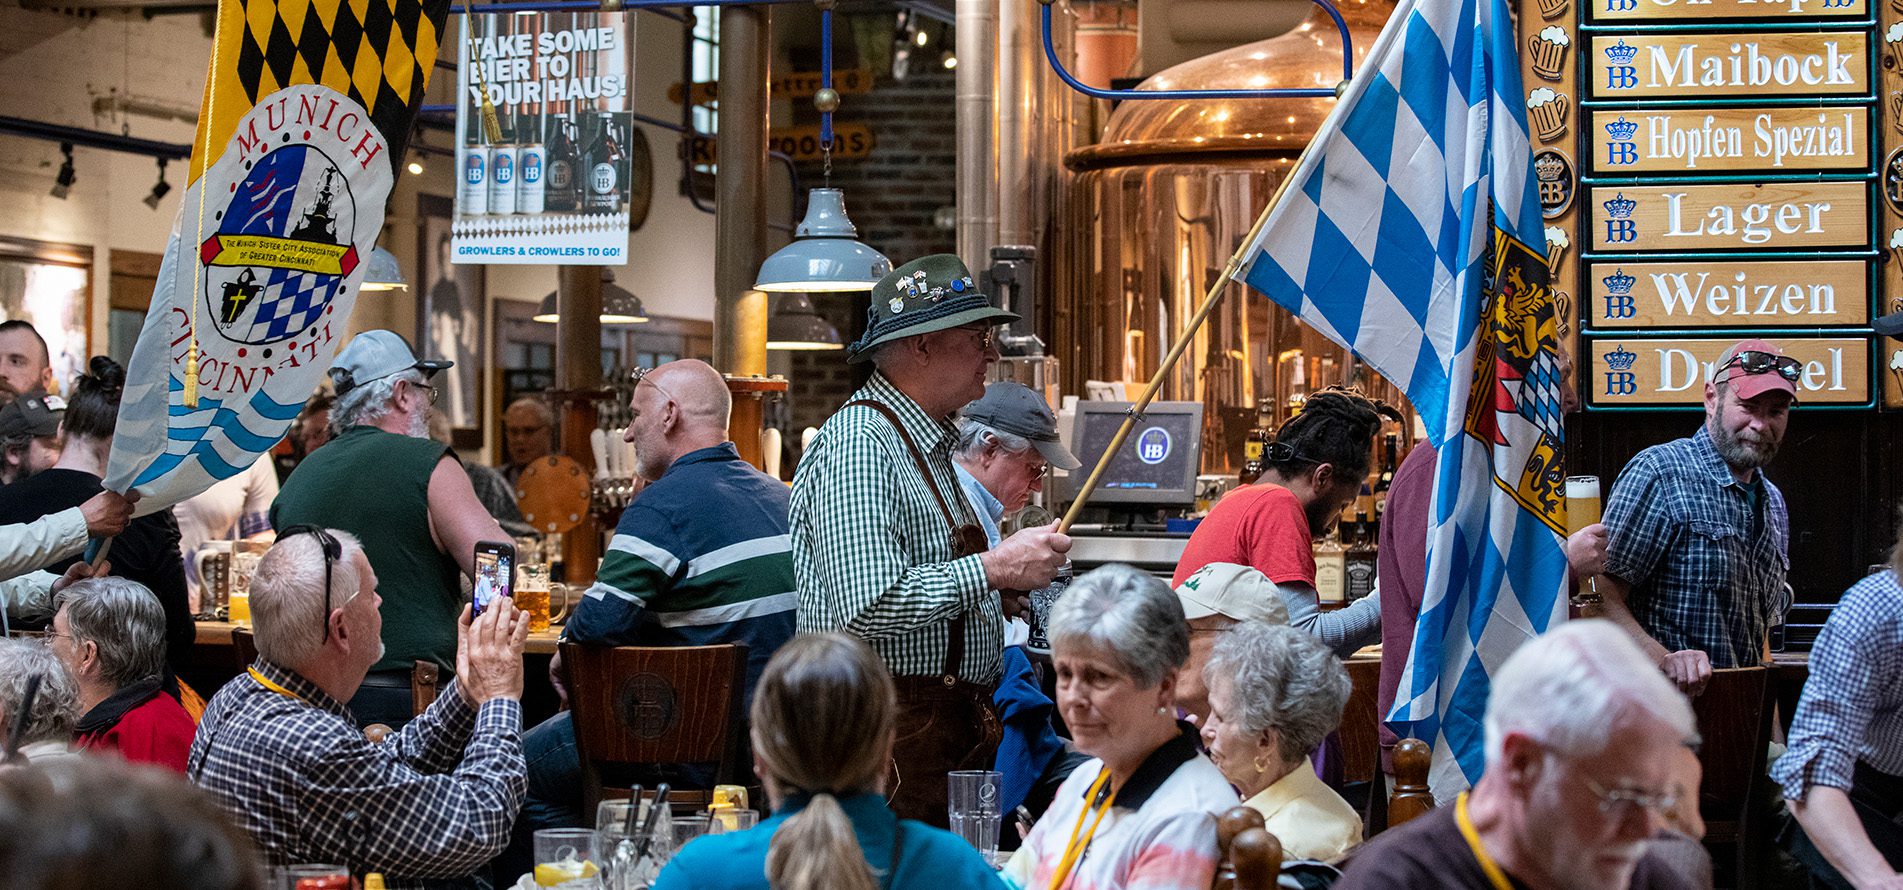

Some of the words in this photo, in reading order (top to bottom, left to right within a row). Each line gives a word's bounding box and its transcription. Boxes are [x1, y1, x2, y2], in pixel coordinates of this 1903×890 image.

[467, 34, 533, 60] TAKE
[537, 27, 615, 54] SOME
[470, 59, 531, 85] BIER
[536, 55, 569, 79] TO
[1606, 66, 1639, 90] HB
[1645, 41, 1855, 88] Maibock
[468, 82, 541, 108] YOUR
[548, 74, 627, 102] HAUS!
[236, 93, 383, 169] MUNICH
[1646, 115, 1743, 168] Hopfen
[1754, 113, 1855, 167] Spezial
[1606, 141, 1639, 165] HB
[1604, 219, 1638, 243] HB
[1662, 193, 1831, 244] Lager
[459, 246, 515, 256] GROWLERS
[518, 247, 526, 256] &
[528, 247, 585, 257] CROWLERS
[587, 248, 600, 256] TO
[602, 248, 620, 257] GO!
[1603, 295, 1637, 320] HB
[1649, 271, 1837, 316] Weizen
[1604, 371, 1637, 396] HB
[1654, 347, 1847, 392] Del
[1144, 444, 1164, 459] HB
